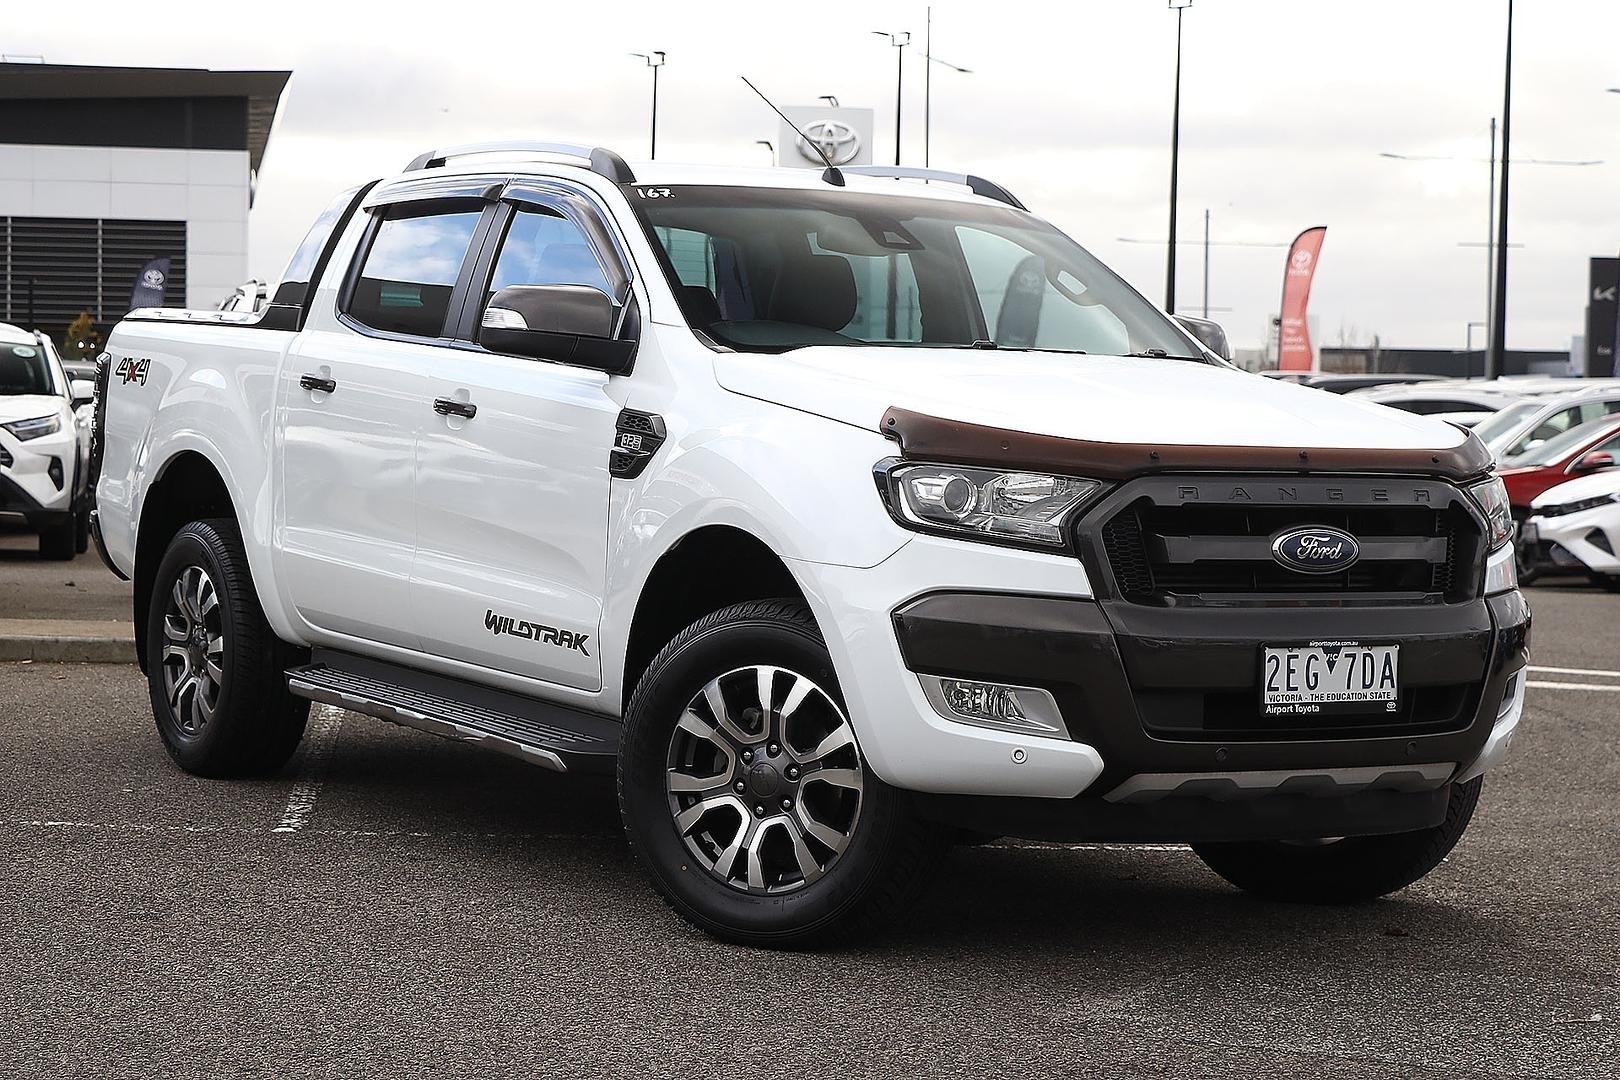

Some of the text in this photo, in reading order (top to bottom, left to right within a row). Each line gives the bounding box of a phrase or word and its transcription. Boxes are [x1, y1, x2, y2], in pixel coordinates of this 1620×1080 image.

[1177, 486, 1431, 502] RANGER
[1296, 535, 1343, 560] Ford
[484, 609, 591, 657] WILDTRAK
[1325, 653, 1339, 661] VIC
[1266, 652, 1396, 692] 2EG 7DA
[1268, 694, 1304, 702] VICTORIA
[1310, 693, 1325, 701] THE
[1326, 692, 1368, 701] EDUCATION
[1369, 691, 1391, 700] STATE
[1265, 704, 1320, 715] Airport Toyota
